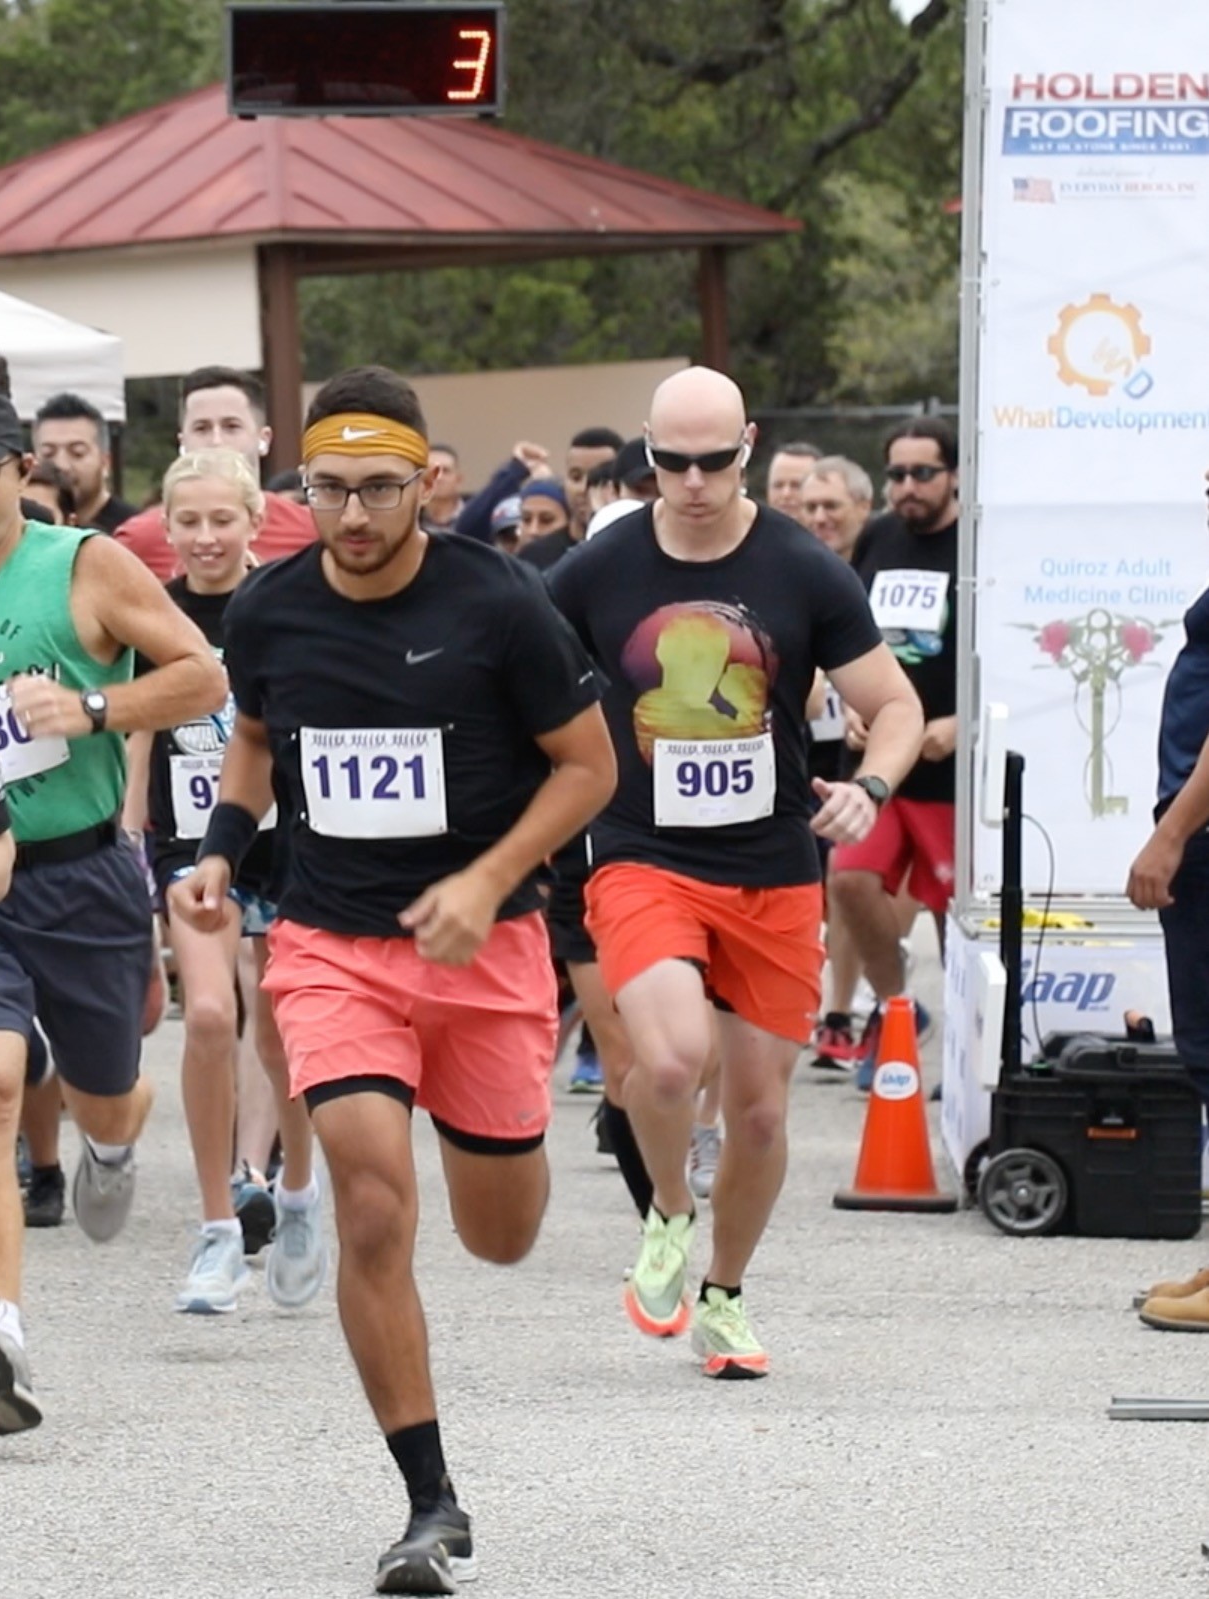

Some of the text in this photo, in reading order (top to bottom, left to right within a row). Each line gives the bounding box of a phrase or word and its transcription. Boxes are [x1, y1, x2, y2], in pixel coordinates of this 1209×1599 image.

[447, 29, 491, 99] 3
[1011, 72, 1209, 101] HOLDEN
[1010, 110, 1209, 139] ROOFING
[992, 404, 1209, 435] WhatDevelopmen
[1040, 558, 1172, 579] Quiroz Adult
[879, 583, 938, 610] 1075
[1024, 585, 1187, 605] Medicine Clinic
[311, 754, 428, 800] 1121
[676, 758, 755, 799] 905
